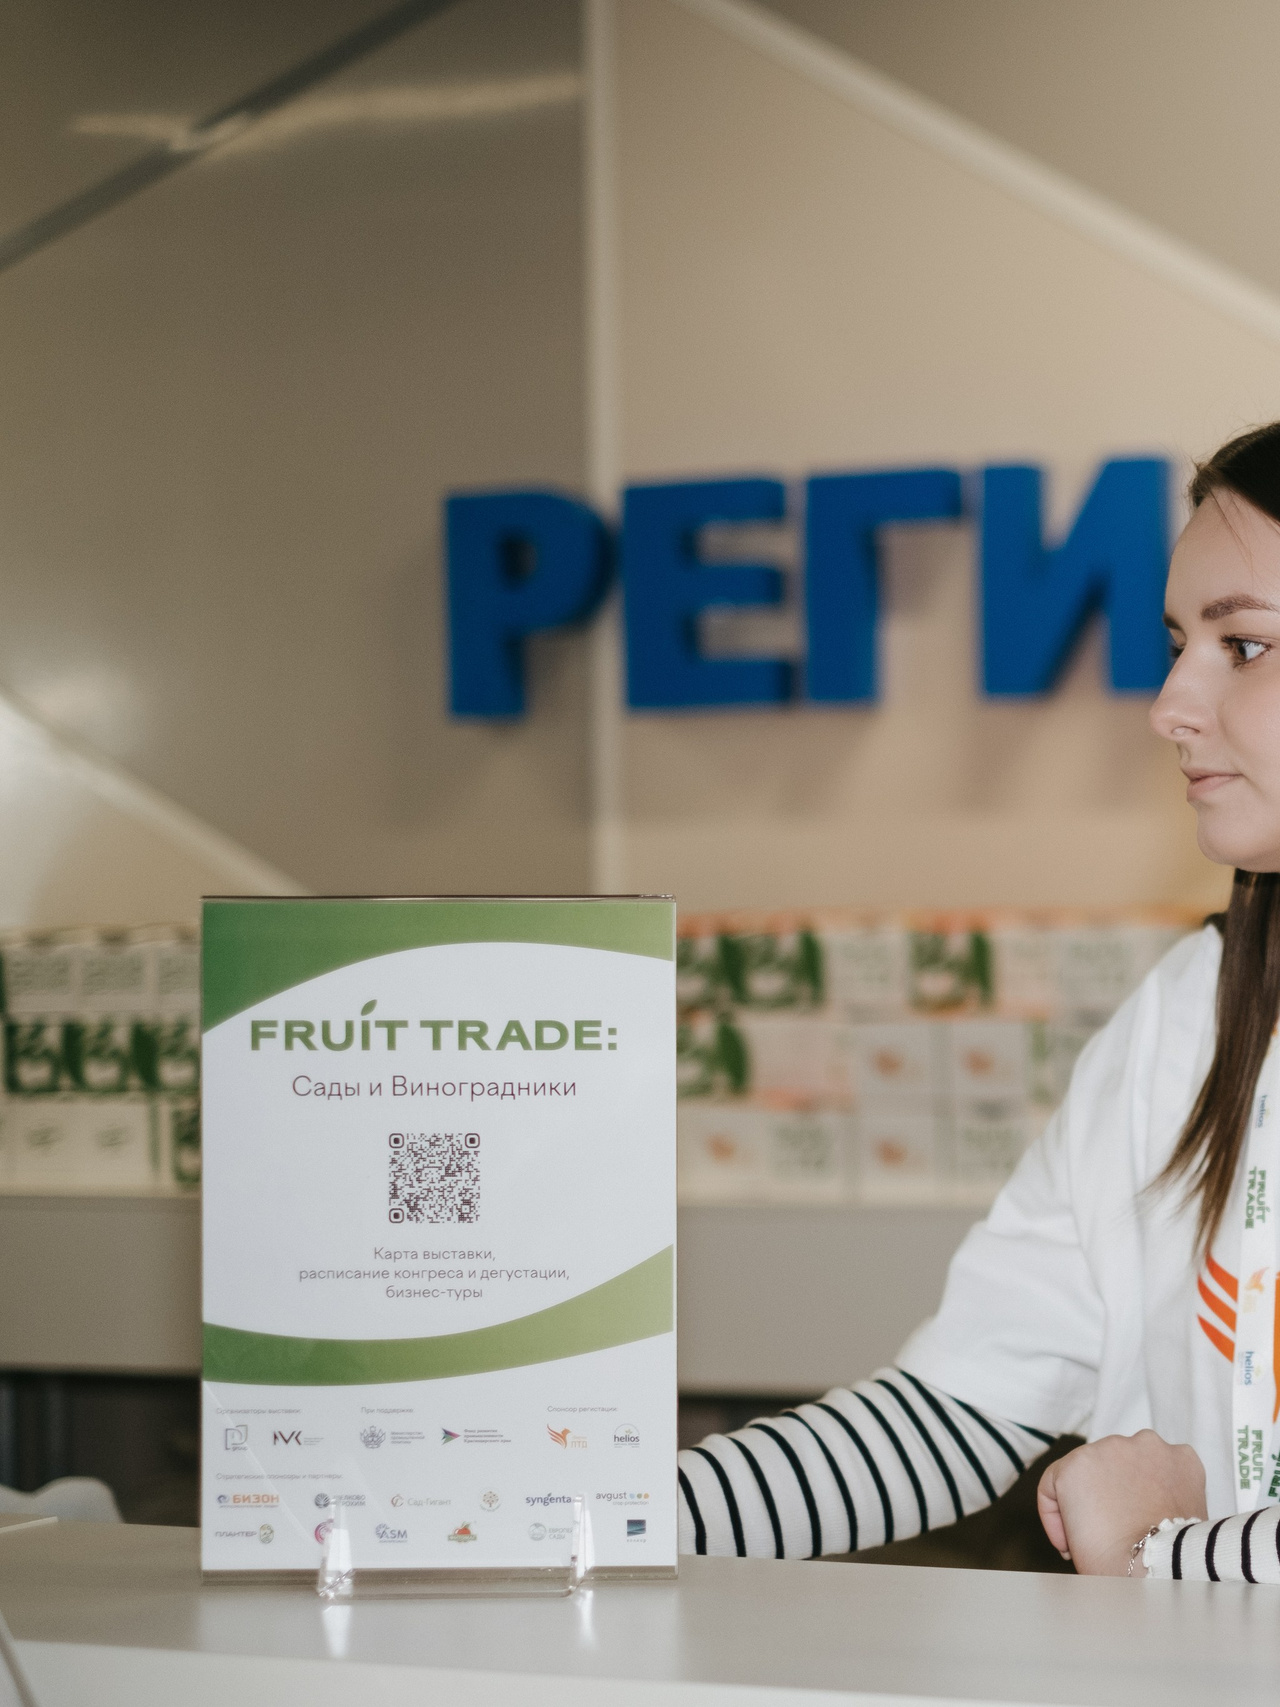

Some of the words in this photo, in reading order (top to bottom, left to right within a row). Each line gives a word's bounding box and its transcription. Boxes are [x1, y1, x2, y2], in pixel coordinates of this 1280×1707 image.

[420, 1020, 618, 1051] TRADE:
[292, 1075, 360, 1100] Сады
[369, 1082, 382, 1097] и
[393, 1075, 577, 1102] Виноградники
[1244, 1165, 1258, 1230] TRADE
[373, 1246, 419, 1263] Карта
[422, 1250, 496, 1263] выставки,
[298, 1269, 390, 1283] расписание
[394, 1269, 464, 1282] конгреса
[468, 1269, 477, 1279] и
[479, 1269, 570, 1282] дегустации,
[385, 1284, 483, 1301] бизнес-туры
[1244, 1350, 1255, 1386] helios
[613, 1434, 640, 1443] helios
[1237, 1425, 1252, 1490] TRADE
[232, 1493, 279, 1504] БИЗОН
[525, 1492, 572, 1507] syngenta
[595, 1491, 628, 1502] avgust
